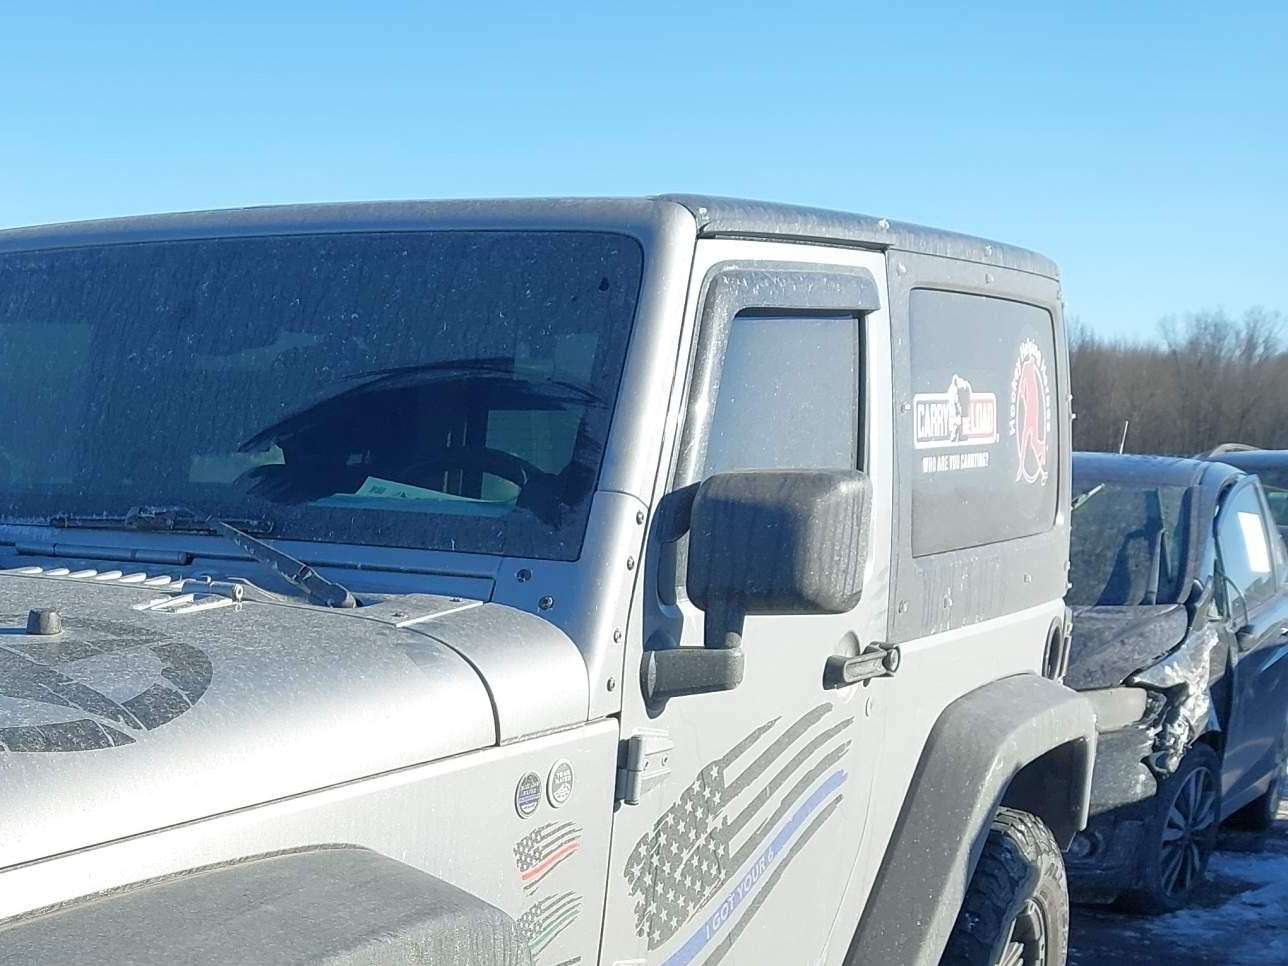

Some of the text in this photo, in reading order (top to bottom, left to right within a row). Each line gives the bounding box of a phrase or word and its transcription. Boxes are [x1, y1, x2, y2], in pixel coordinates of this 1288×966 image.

[917, 402, 949, 437] CARRY
[971, 400, 993, 434] LOAD
[705, 846, 774, 940] I GOT YOUR 6
